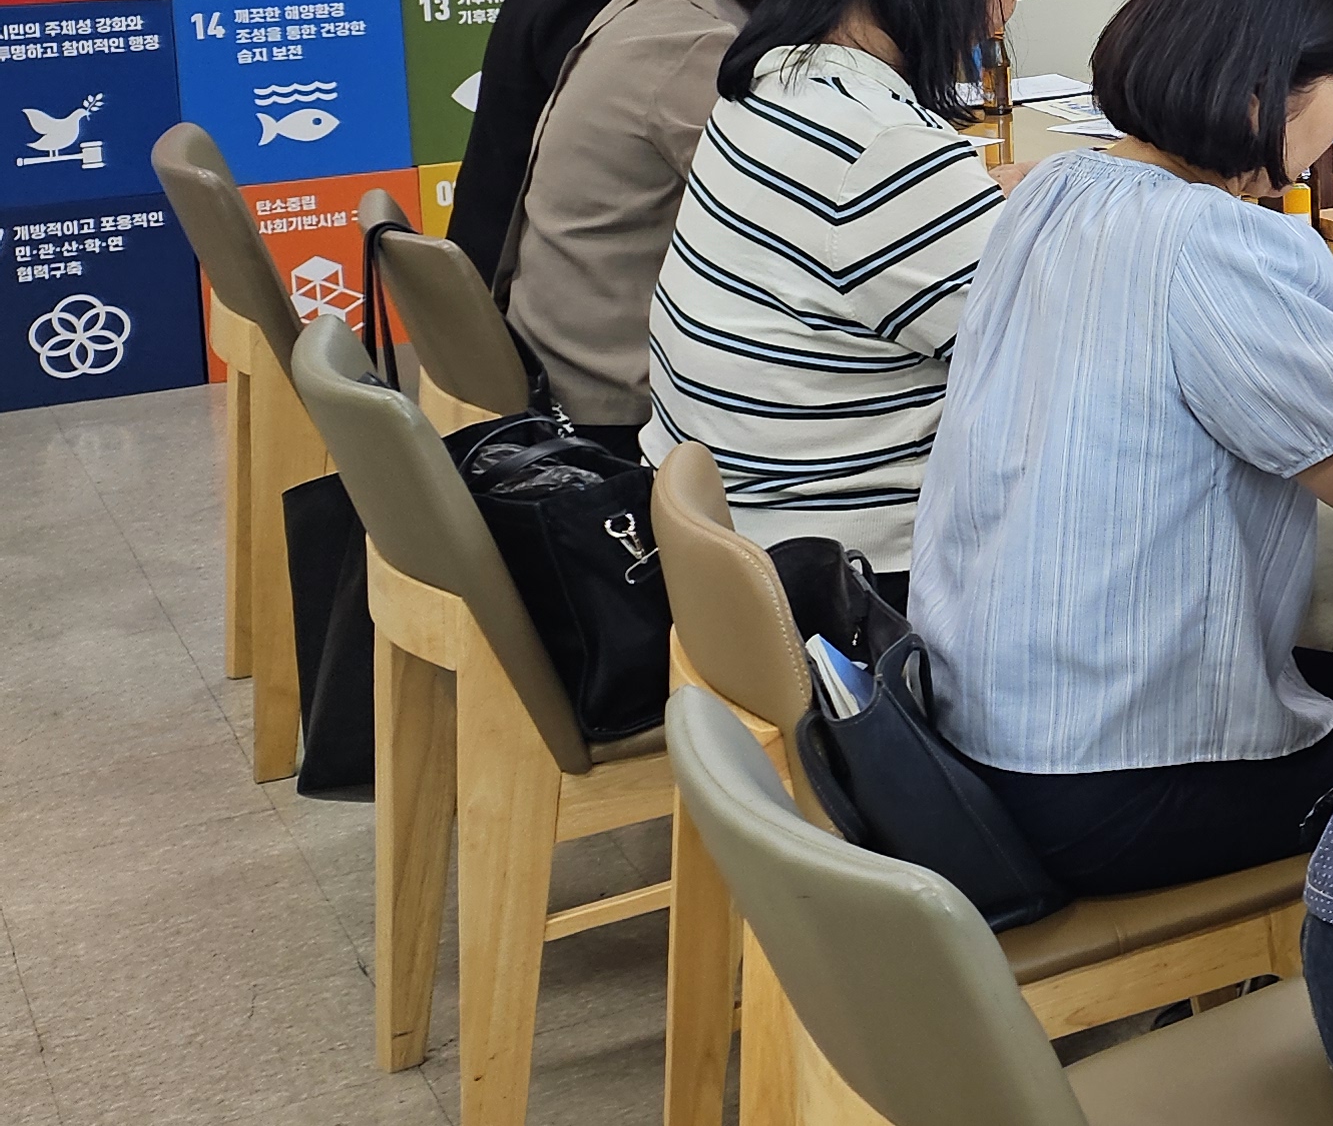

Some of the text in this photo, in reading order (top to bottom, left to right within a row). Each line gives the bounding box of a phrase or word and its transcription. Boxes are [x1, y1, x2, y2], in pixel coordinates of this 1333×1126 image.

[233, 2, 345, 24] 깨끗한 해양환경
[44, 19, 92, 37] 주체성
[95, 15, 144, 34] 강화와
[190, 11, 226, 40] 14
[235, 20, 367, 44] 조성을 통한 건강한
[62, 37, 126, 57] 참여적인
[128, 34, 161, 52] 행정
[236, 44, 304, 65] 습지 보전
[436, 180, 456, 207] 0
[255, 195, 317, 216] 탄소중립
[13, 218, 96, 242] 개방적이고
[100, 210, 165, 232] 포용적인
[258, 210, 348, 235] 사회기반시설
[16, 260, 83, 283] 협력구축
